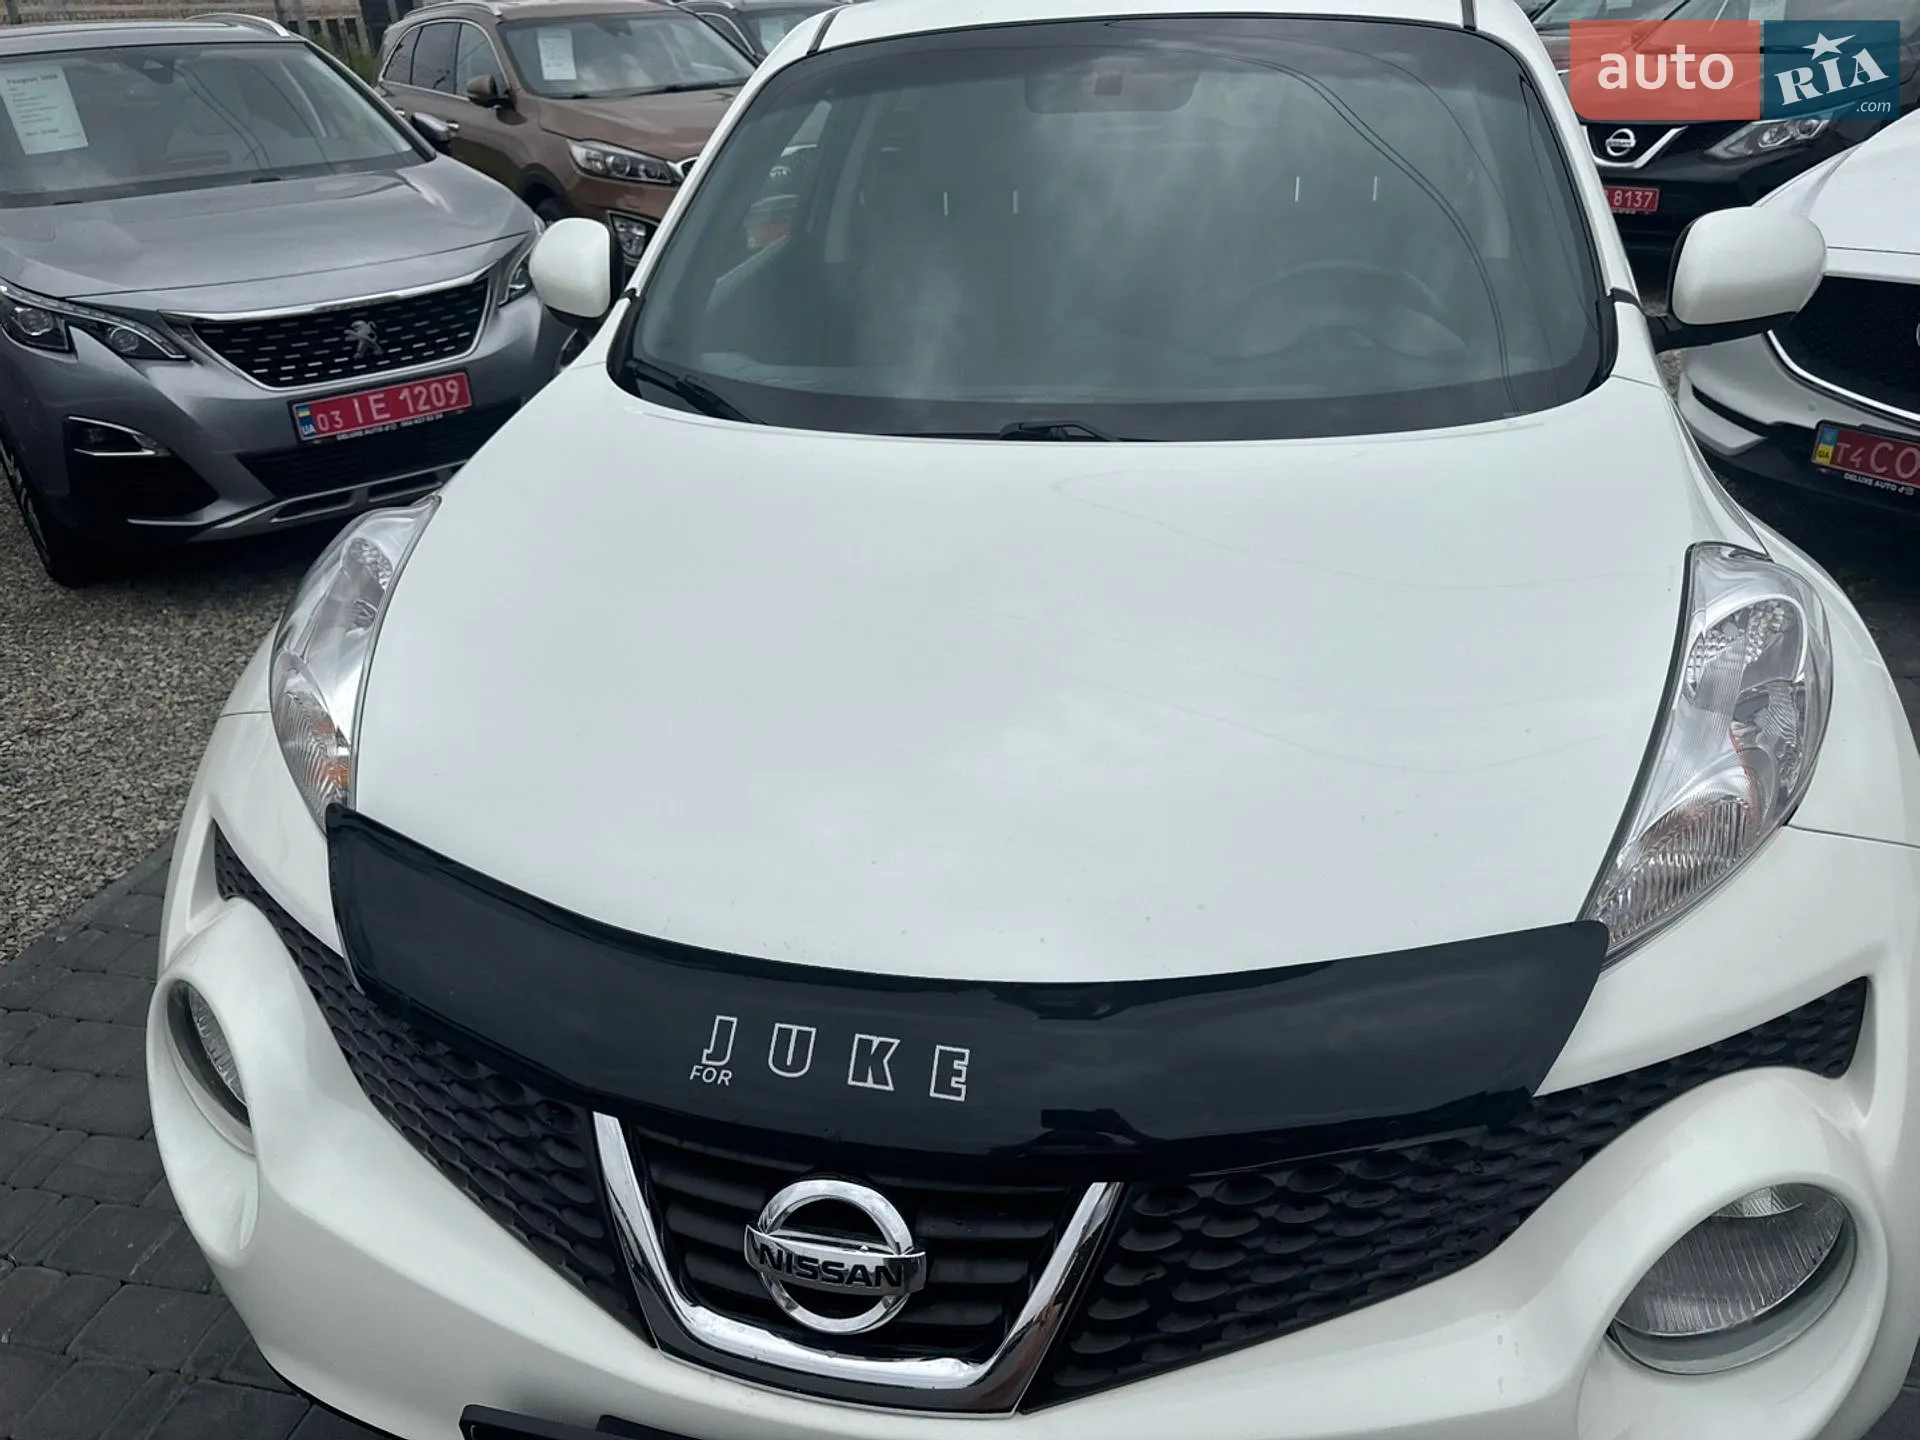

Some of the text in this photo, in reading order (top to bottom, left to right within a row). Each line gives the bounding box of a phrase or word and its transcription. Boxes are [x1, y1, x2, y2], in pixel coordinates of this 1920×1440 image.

[1613, 190, 1653, 208] 8137
[316, 410, 343, 431] 03
[353, 394, 390, 424] IE
[399, 380, 459, 414] 1209
[302, 424, 316, 435] UA
[701, 1015, 970, 1101] JUKE
[689, 1065, 732, 1086] FOR
[759, 1243, 902, 1287] NISSAN
